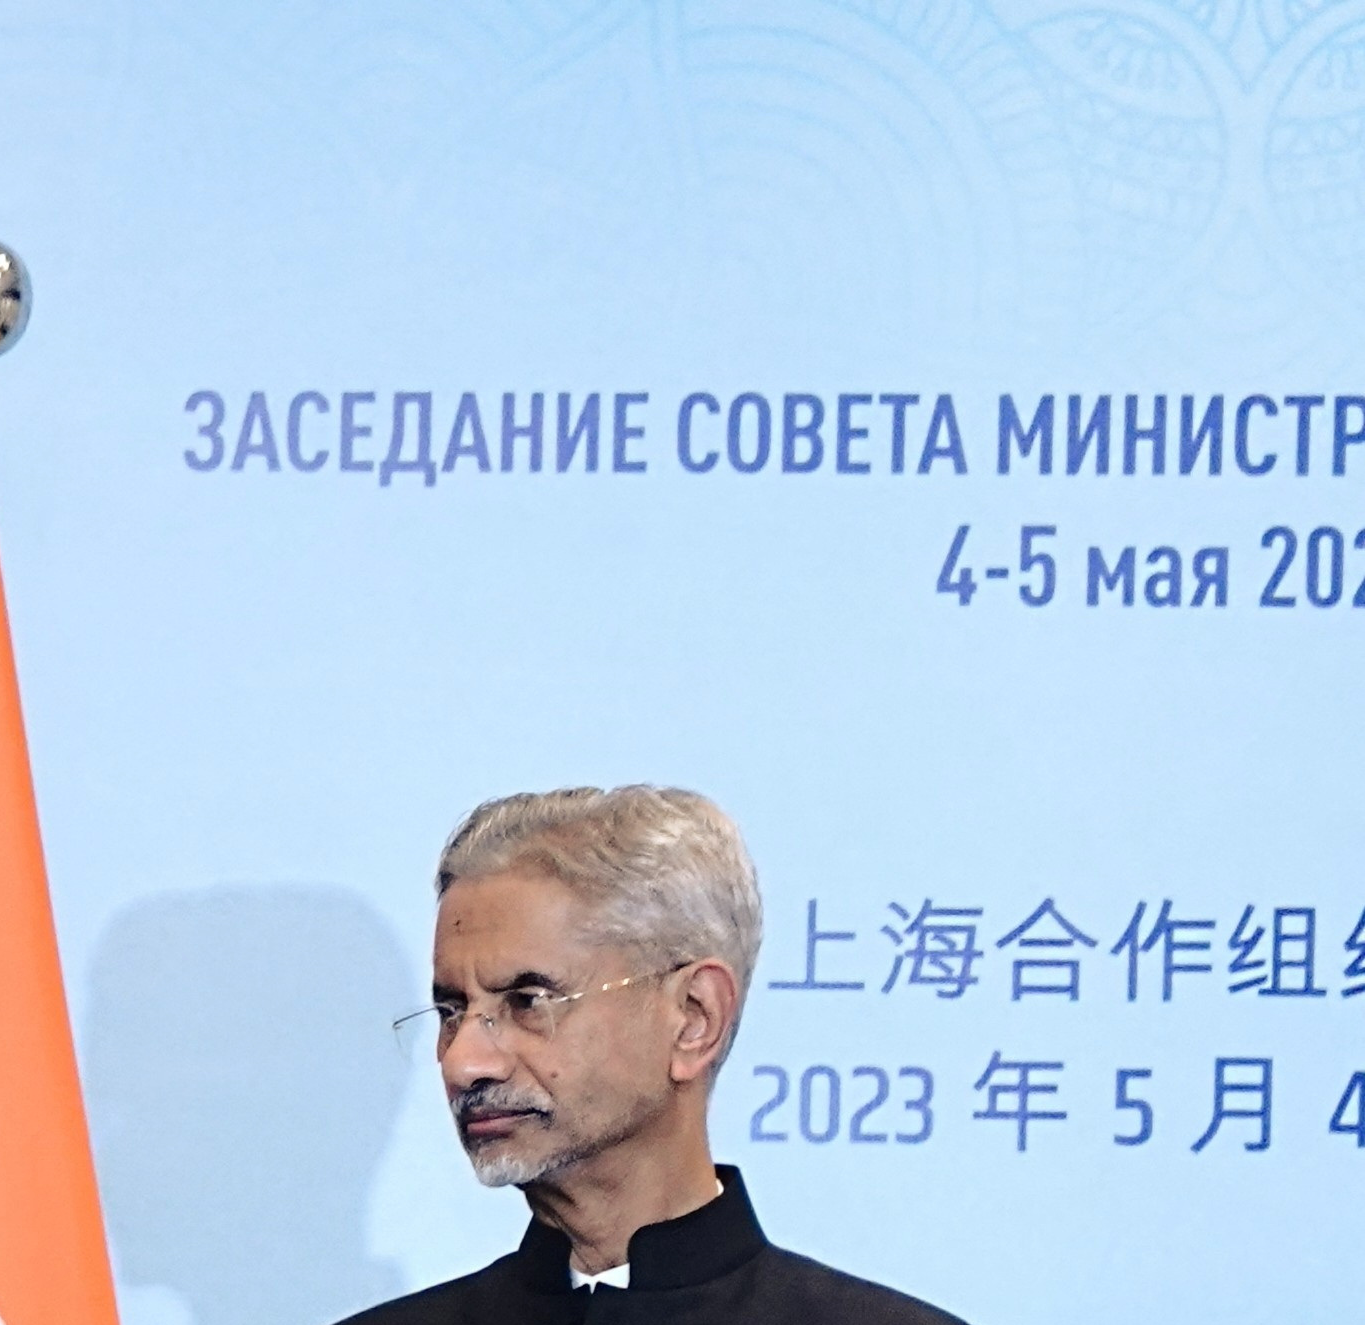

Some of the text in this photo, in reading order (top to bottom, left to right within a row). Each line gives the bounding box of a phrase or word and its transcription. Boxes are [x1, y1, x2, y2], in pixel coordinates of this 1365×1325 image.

[184, 390, 650, 488] ЗАСЕДАНИЕ
[677, 391, 968, 475] СОВЕТА
[936, 524, 1057, 608] 4-5
[1086, 545, 1229, 608] мая
[768, 897, 1365, 1001] 上海合作组
[750, 1064, 934, 1145] 2023
[972, 1050, 1068, 1152] 年
[1114, 1068, 1153, 1147] 5
[1190, 1057, 1273, 1153] 月
